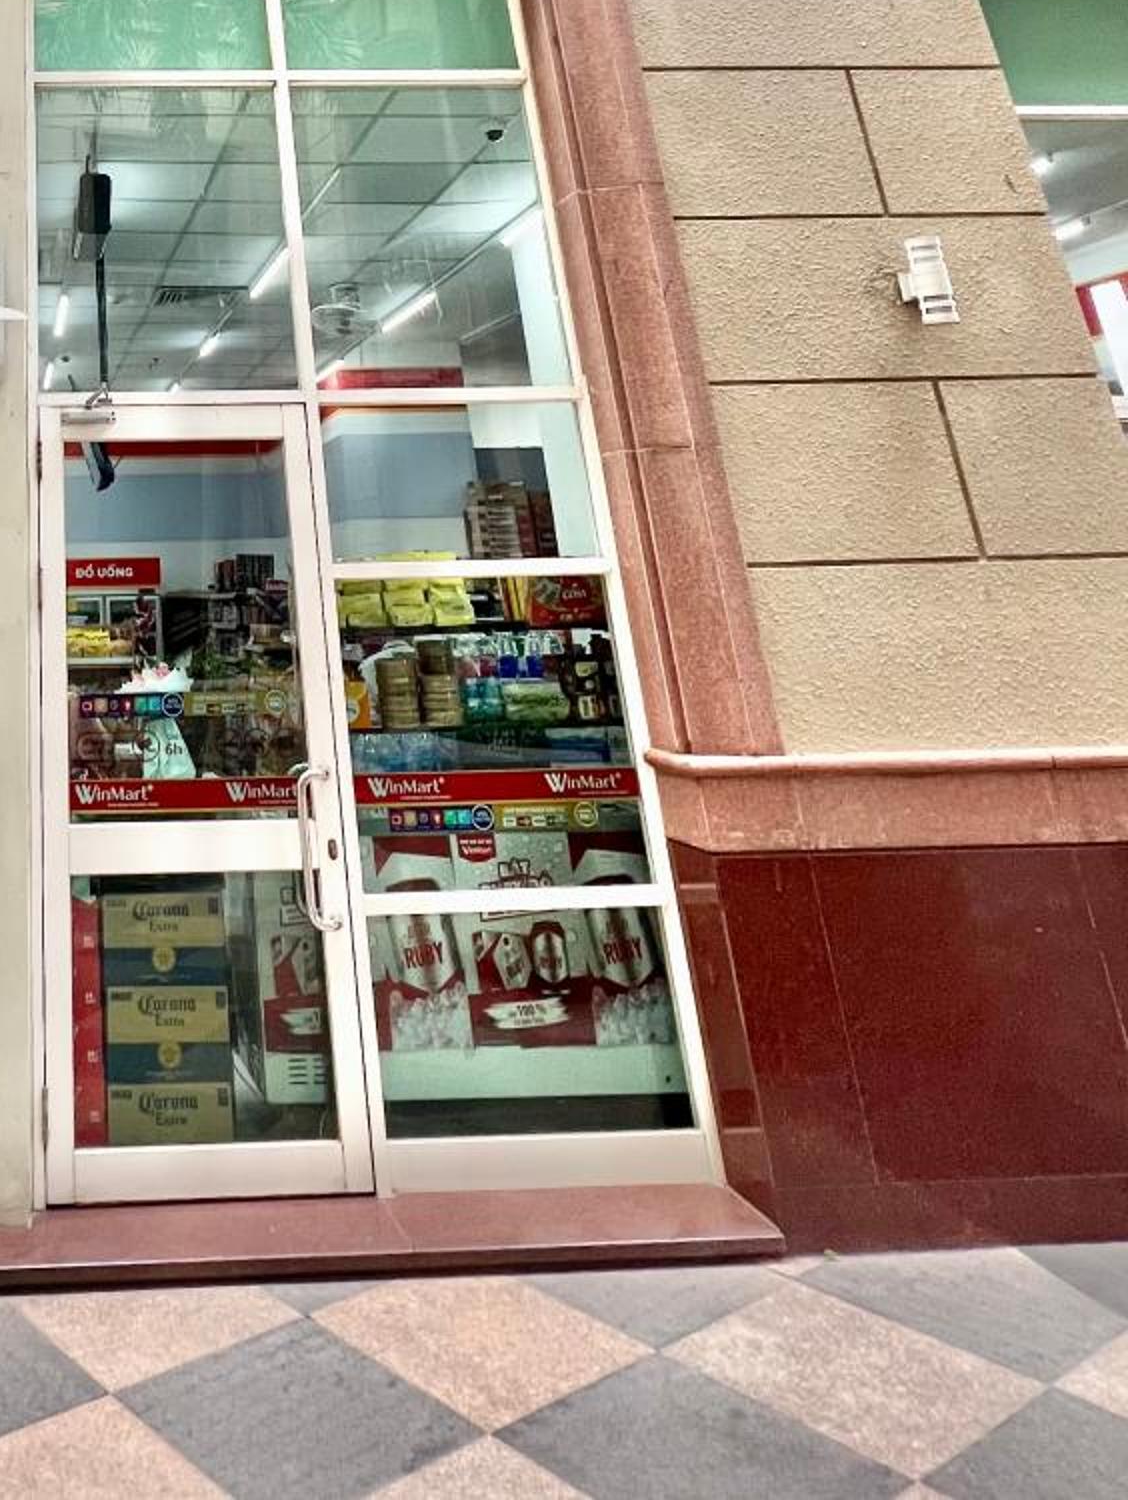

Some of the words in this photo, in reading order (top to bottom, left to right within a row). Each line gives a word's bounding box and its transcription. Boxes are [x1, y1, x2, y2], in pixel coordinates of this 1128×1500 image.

[225, 782, 298, 803] WinMart
[132, 901, 190, 921] Corona
[403, 941, 444, 969] RUBY
[602, 937, 644, 965] RUBY
[137, 995, 197, 1016] Corona
[138, 1090, 199, 1114] Corona
